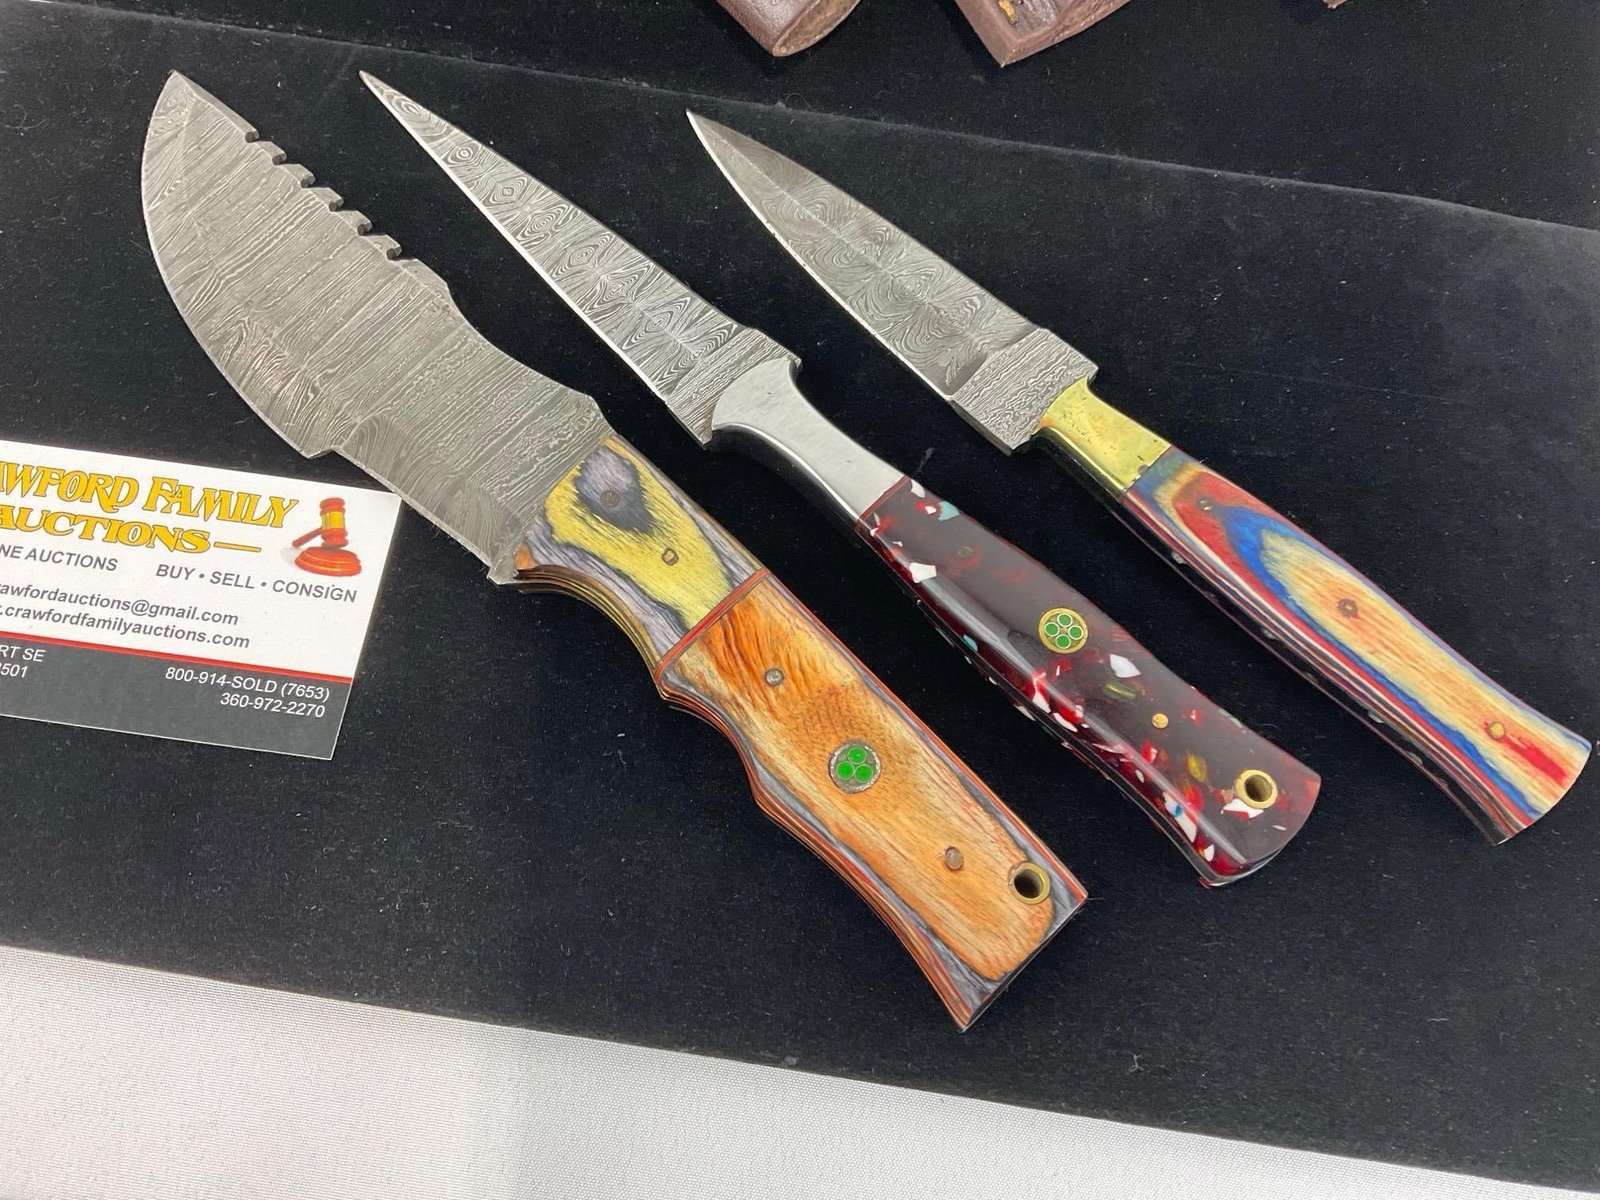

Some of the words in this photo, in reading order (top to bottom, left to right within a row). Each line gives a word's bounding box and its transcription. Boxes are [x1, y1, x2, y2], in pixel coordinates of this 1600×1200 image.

[0, 461, 139, 513] WFORD
[143, 475, 299, 528] FAMILY
[25, 548, 118, 572] AUCTIONS
[156, 563, 196, 580] BUY
[210, 571, 255, 589] SELL
[273, 579, 357, 603] CONSIGN
[22, 648, 46, 662] SE
[165, 667, 277, 693] 800-914-SOLD
[281, 682, 330, 702] (7653)
[220, 692, 325, 718] 360-972-2270
